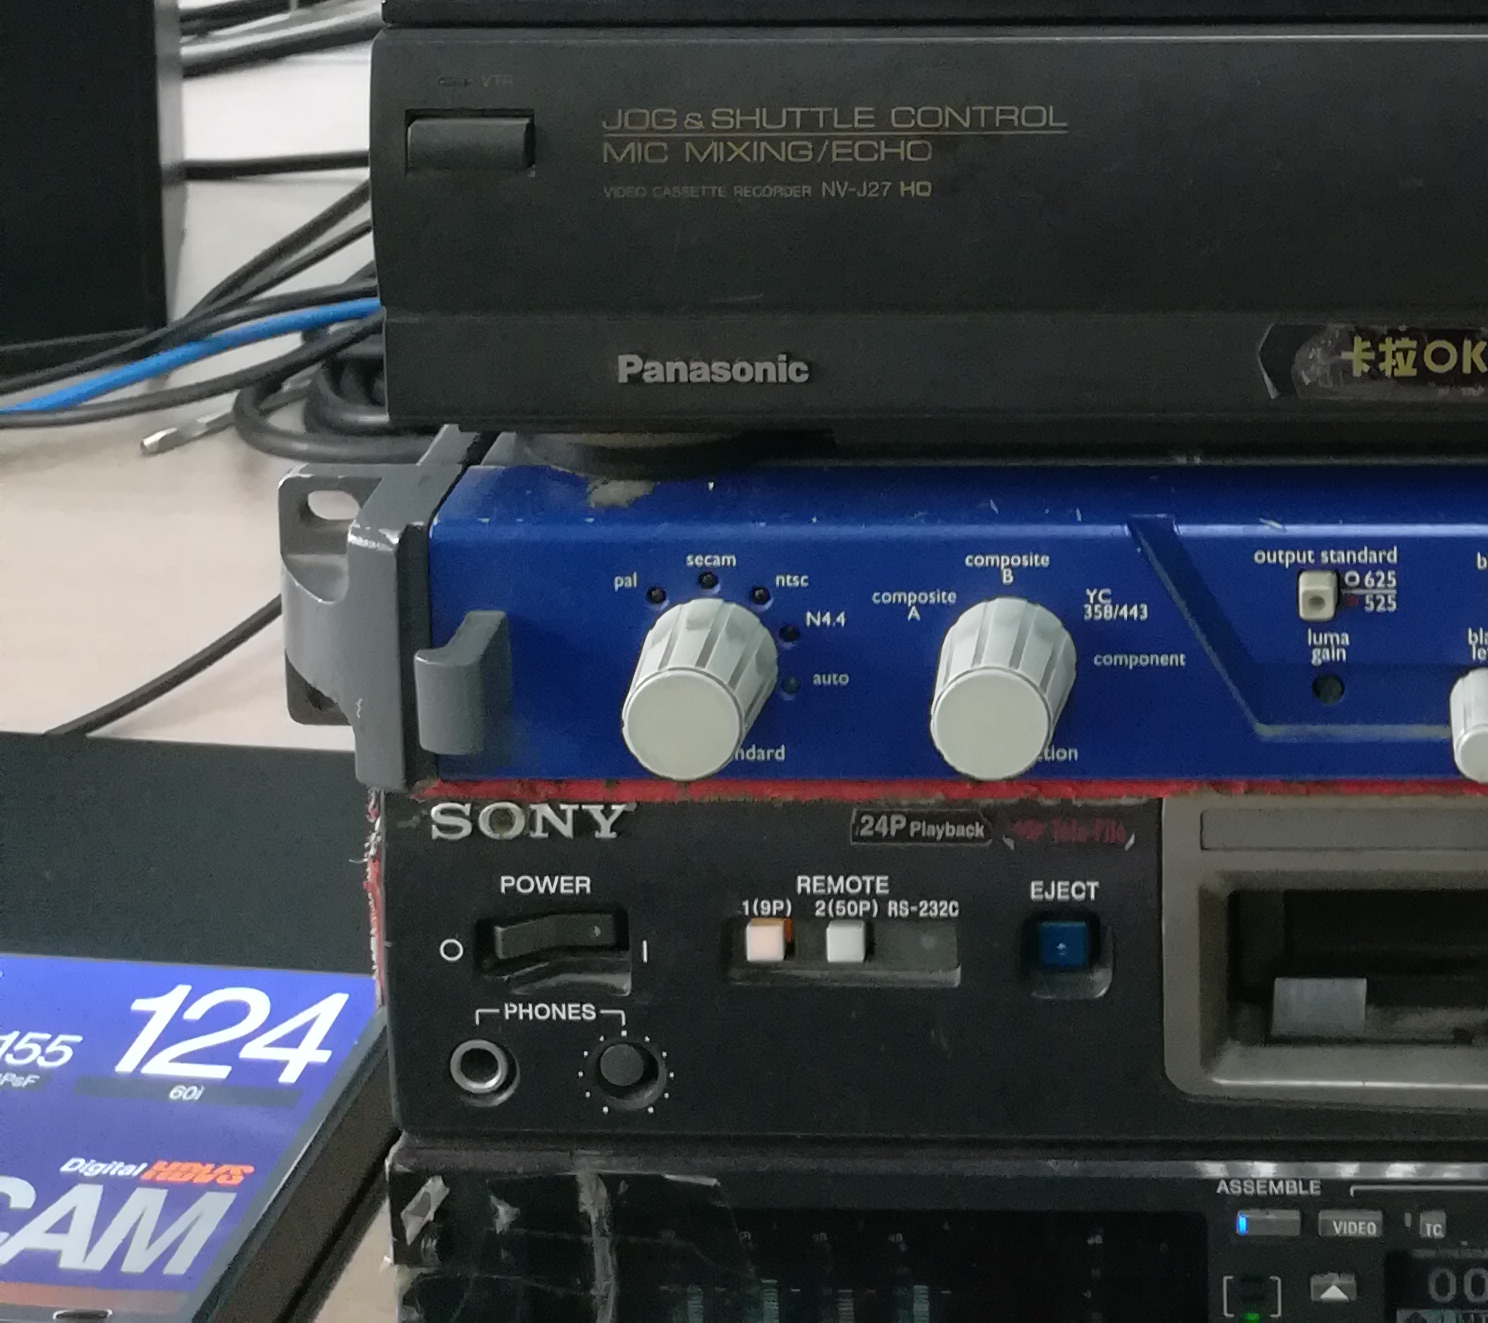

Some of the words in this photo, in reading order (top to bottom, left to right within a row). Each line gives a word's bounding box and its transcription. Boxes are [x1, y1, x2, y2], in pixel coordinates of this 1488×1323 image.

[890, 105, 1069, 129] CONTROL
[602, 140, 669, 164] MIC
[685, 140, 933, 163] MIXING/ECHO
[603, 185, 648, 199] VIDEO
[652, 185, 728, 199] CASSETTE
[733, 184, 813, 199] RECORDER
[820, 181, 893, 199] NV-J27
[1341, 334, 1488, 379] 卡拉OK
[617, 353, 811, 384] Panasonic
[685, 553, 737, 568] secam
[964, 553, 1050, 571] composite
[1253, 547, 1315, 566] output
[1320, 546, 1398, 565] standard
[613, 572, 638, 591] pal
[775, 572, 810, 587] ntsc
[1364, 571, 1397, 588] 625
[872, 589, 957, 607] composite
[1364, 594, 1397, 612] 525
[805, 611, 847, 628] N4.4
[1083, 603, 1149, 621] 358/443
[1306, 628, 1350, 645] luma
[1093, 651, 1185, 669] component
[1311, 645, 1347, 665] gain
[812, 670, 849, 687] auto
[430, 802, 628, 842] SONY
[859, 814, 907, 837] 24P
[909, 820, 985, 841] Playback
[500, 875, 592, 895] POWER
[797, 875, 890, 895] REMOTE
[1030, 880, 1100, 902] EJECT
[742, 898, 794, 919] 1(9P)
[815, 898, 880, 920] 2(50P)
[887, 899, 960, 918] RS-232C
[503, 1002, 597, 1021] PHONES
[114, 984, 350, 1083] 124
[168, 1084, 205, 1103] 60i
[60, 1157, 147, 1178] Digital
[1216, 1179, 1322, 1196] ASSEMBLE
[1332, 1220, 1378, 1236] VIDEO
